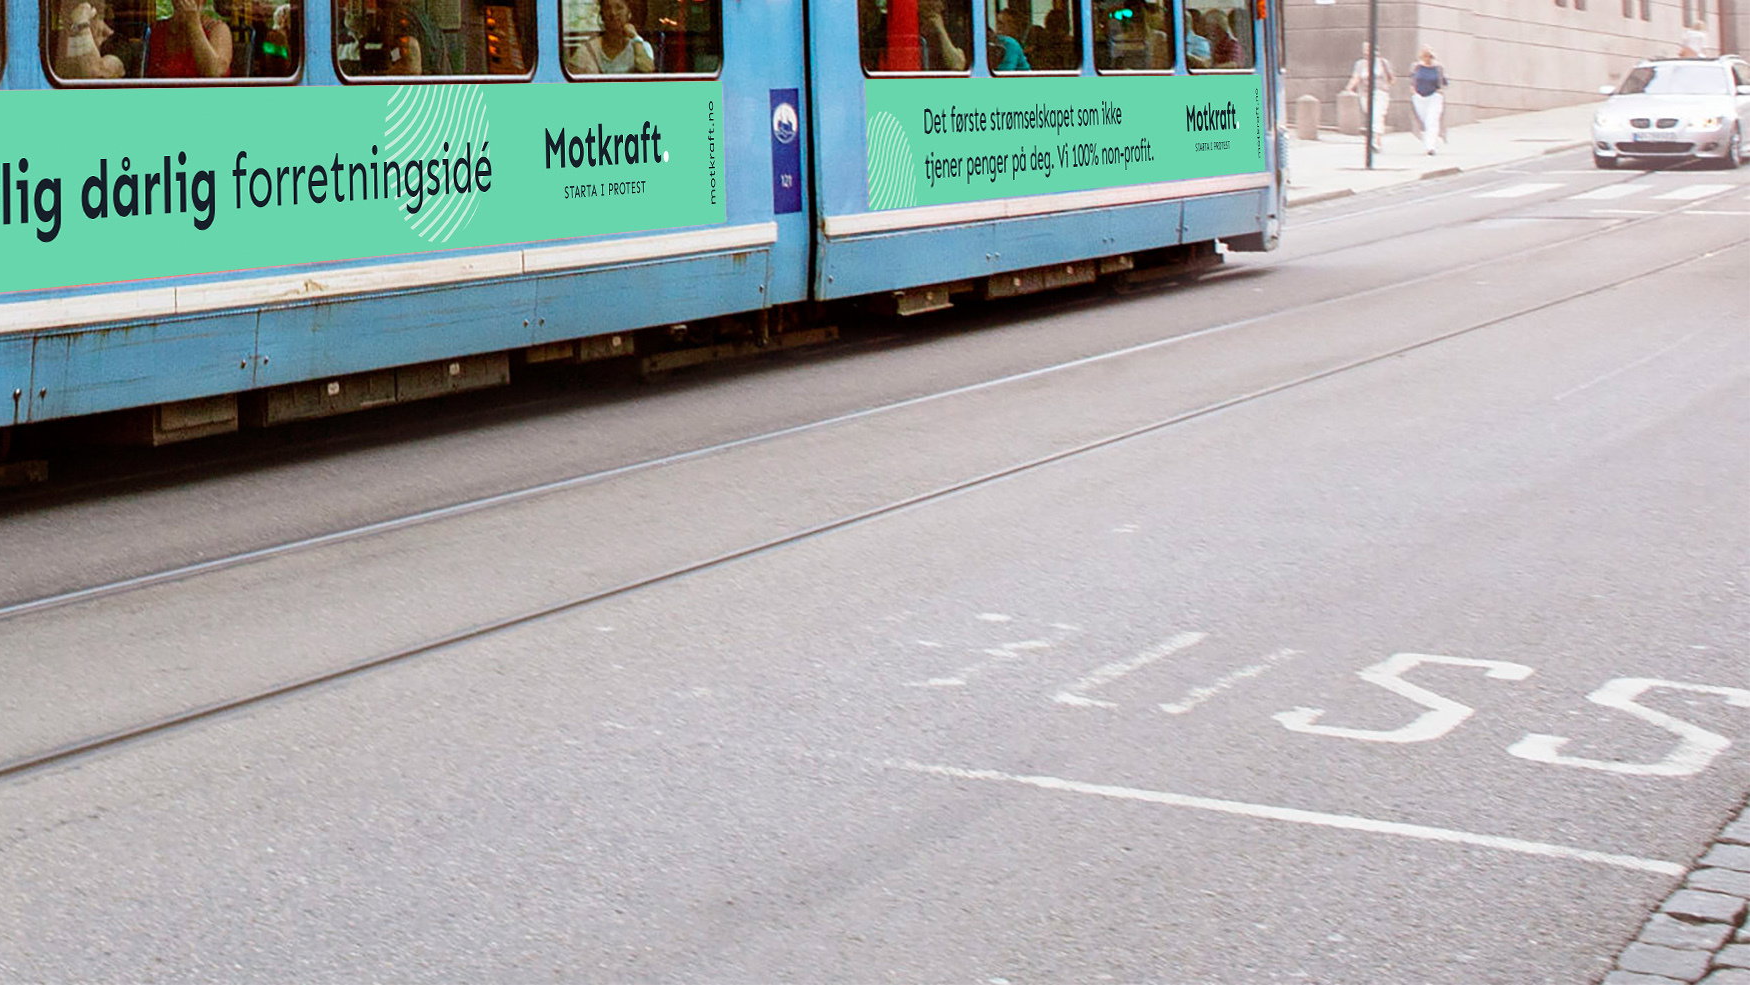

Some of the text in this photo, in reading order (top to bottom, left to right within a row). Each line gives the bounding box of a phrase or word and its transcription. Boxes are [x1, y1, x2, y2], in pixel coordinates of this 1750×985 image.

[923, 100, 1123, 136] Det første strømselskapet som ikke
[1185, 100, 1240, 132] Motkraft.
[544, 120, 670, 169] Motkraft.
[707, 100, 717, 205] motkraft.no
[924, 137, 1155, 188] tjener penger på deg. Vi 100% non-profit.
[1194, 142, 1209, 152] STARTA
[81, 150, 216, 231] dårlig
[232, 141, 492, 215] forretningsidé
[564, 180, 647, 199] STARTA I PROTEST
